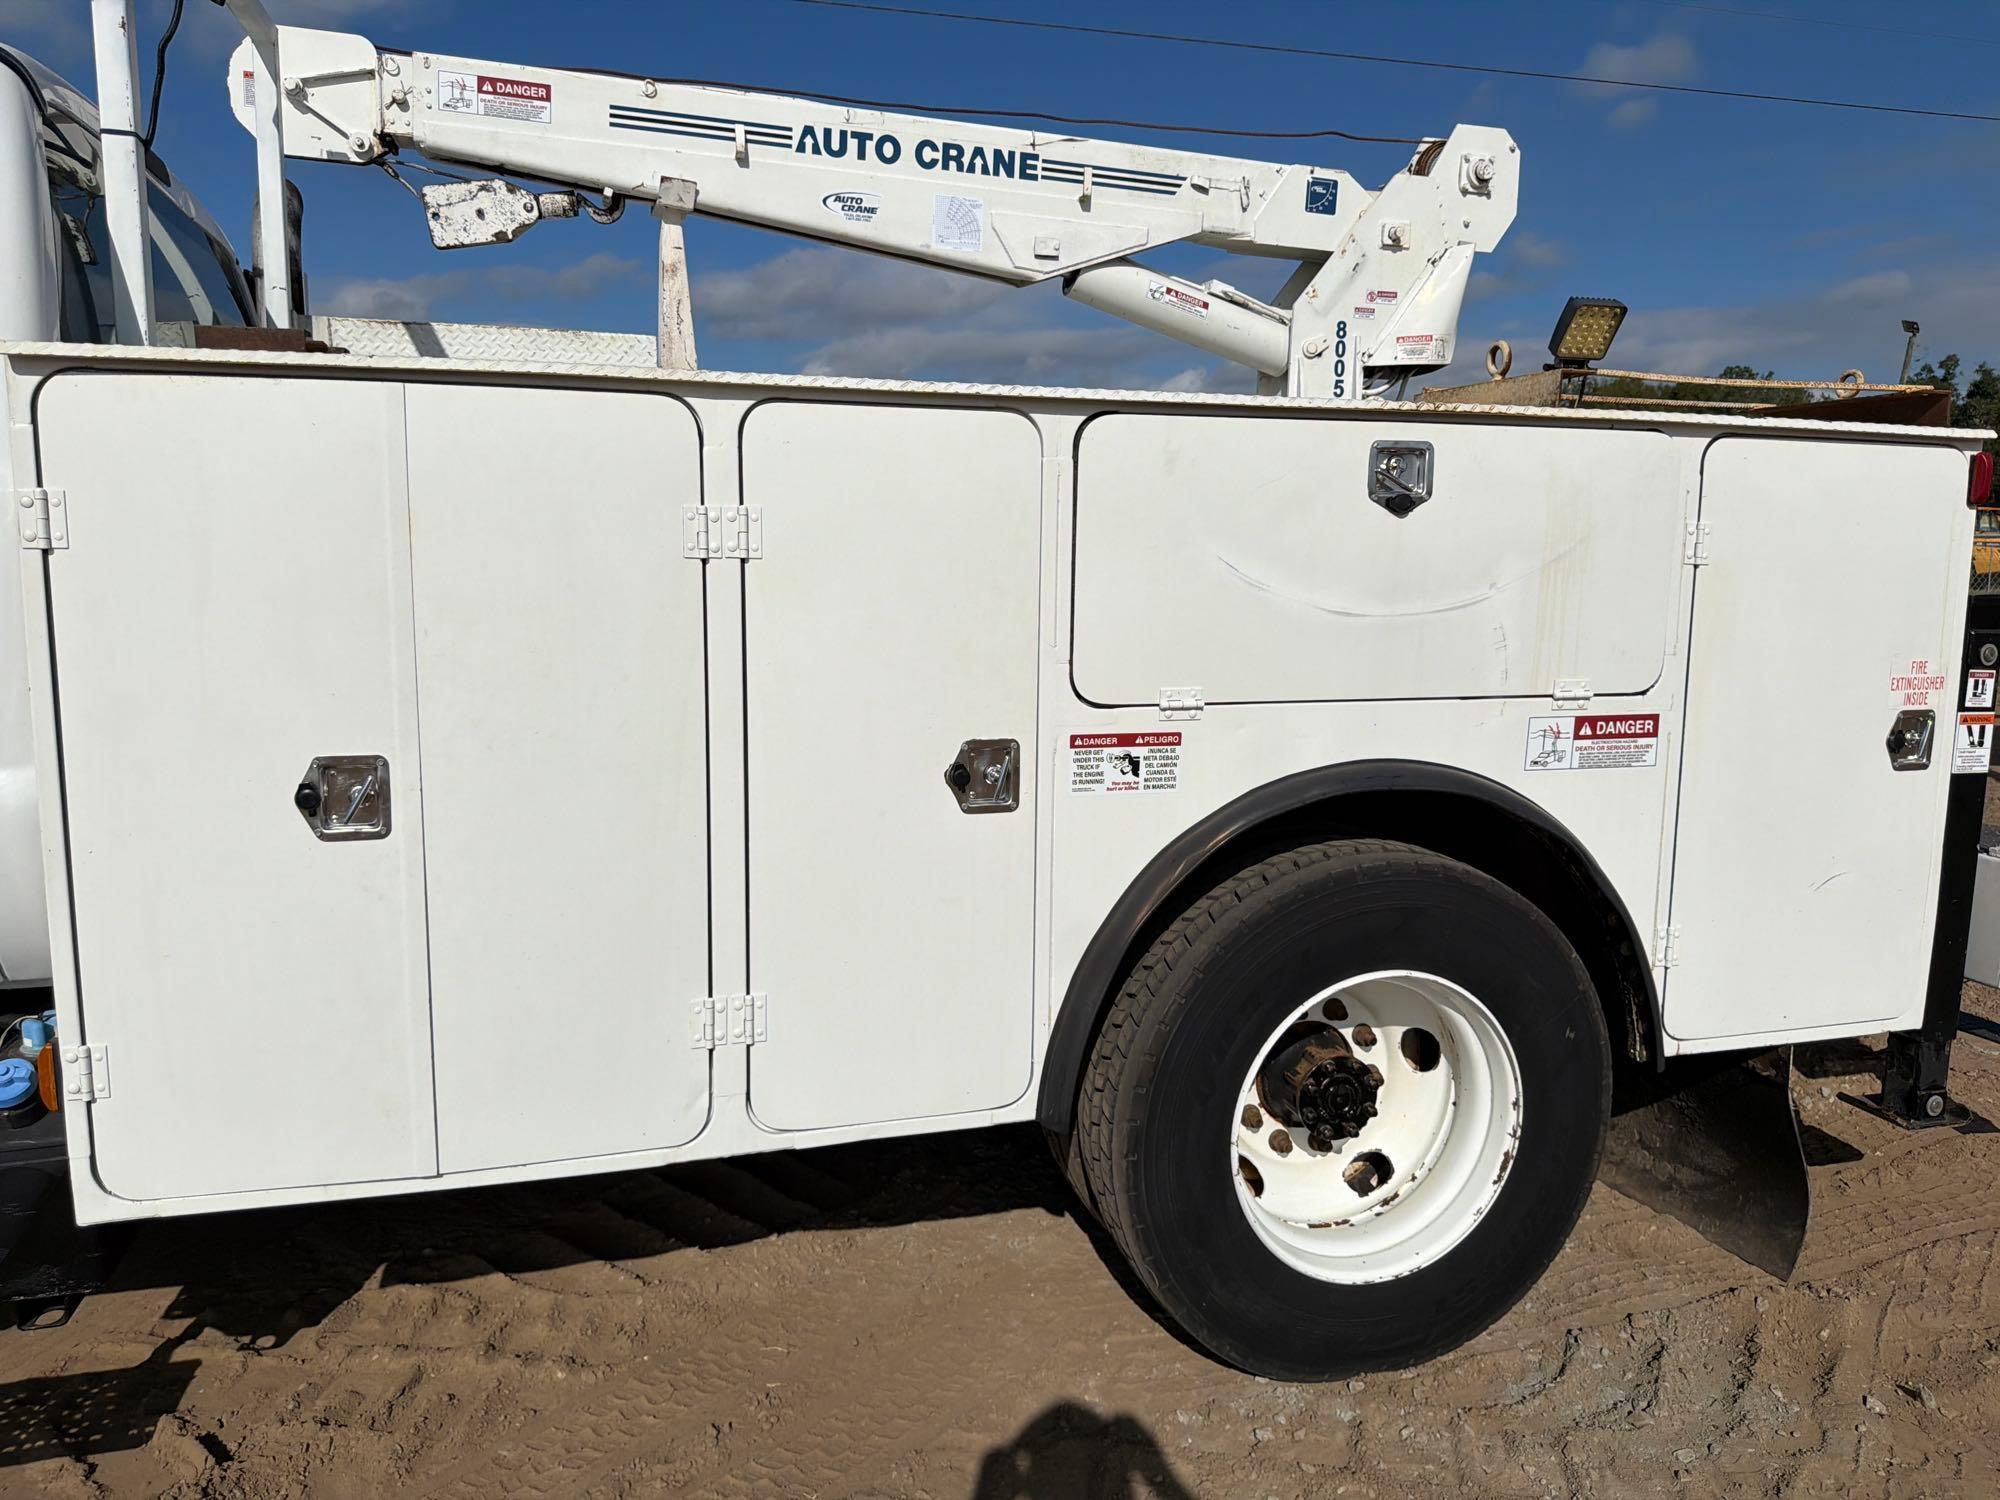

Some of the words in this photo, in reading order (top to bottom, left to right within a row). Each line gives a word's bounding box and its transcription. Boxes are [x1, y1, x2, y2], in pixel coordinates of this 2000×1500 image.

[496, 82, 547, 98] DANGER
[795, 125, 901, 165] AUTO
[915, 139, 1040, 182] CRANE
[833, 195, 863, 205] AUTO
[841, 204, 878, 215] CRANE
[1177, 292, 1204, 306] DANGER
[1333, 320, 1347, 398] 8005
[1911, 660, 1928, 675] FIRE
[1890, 676, 1945, 692] EXTINGUISHER
[1903, 692, 1929, 706] INSIDE
[1596, 720, 1654, 735] DANGER
[1083, 737, 1118, 746] DANGER
[1144, 735, 1179, 744] PELIGRO
